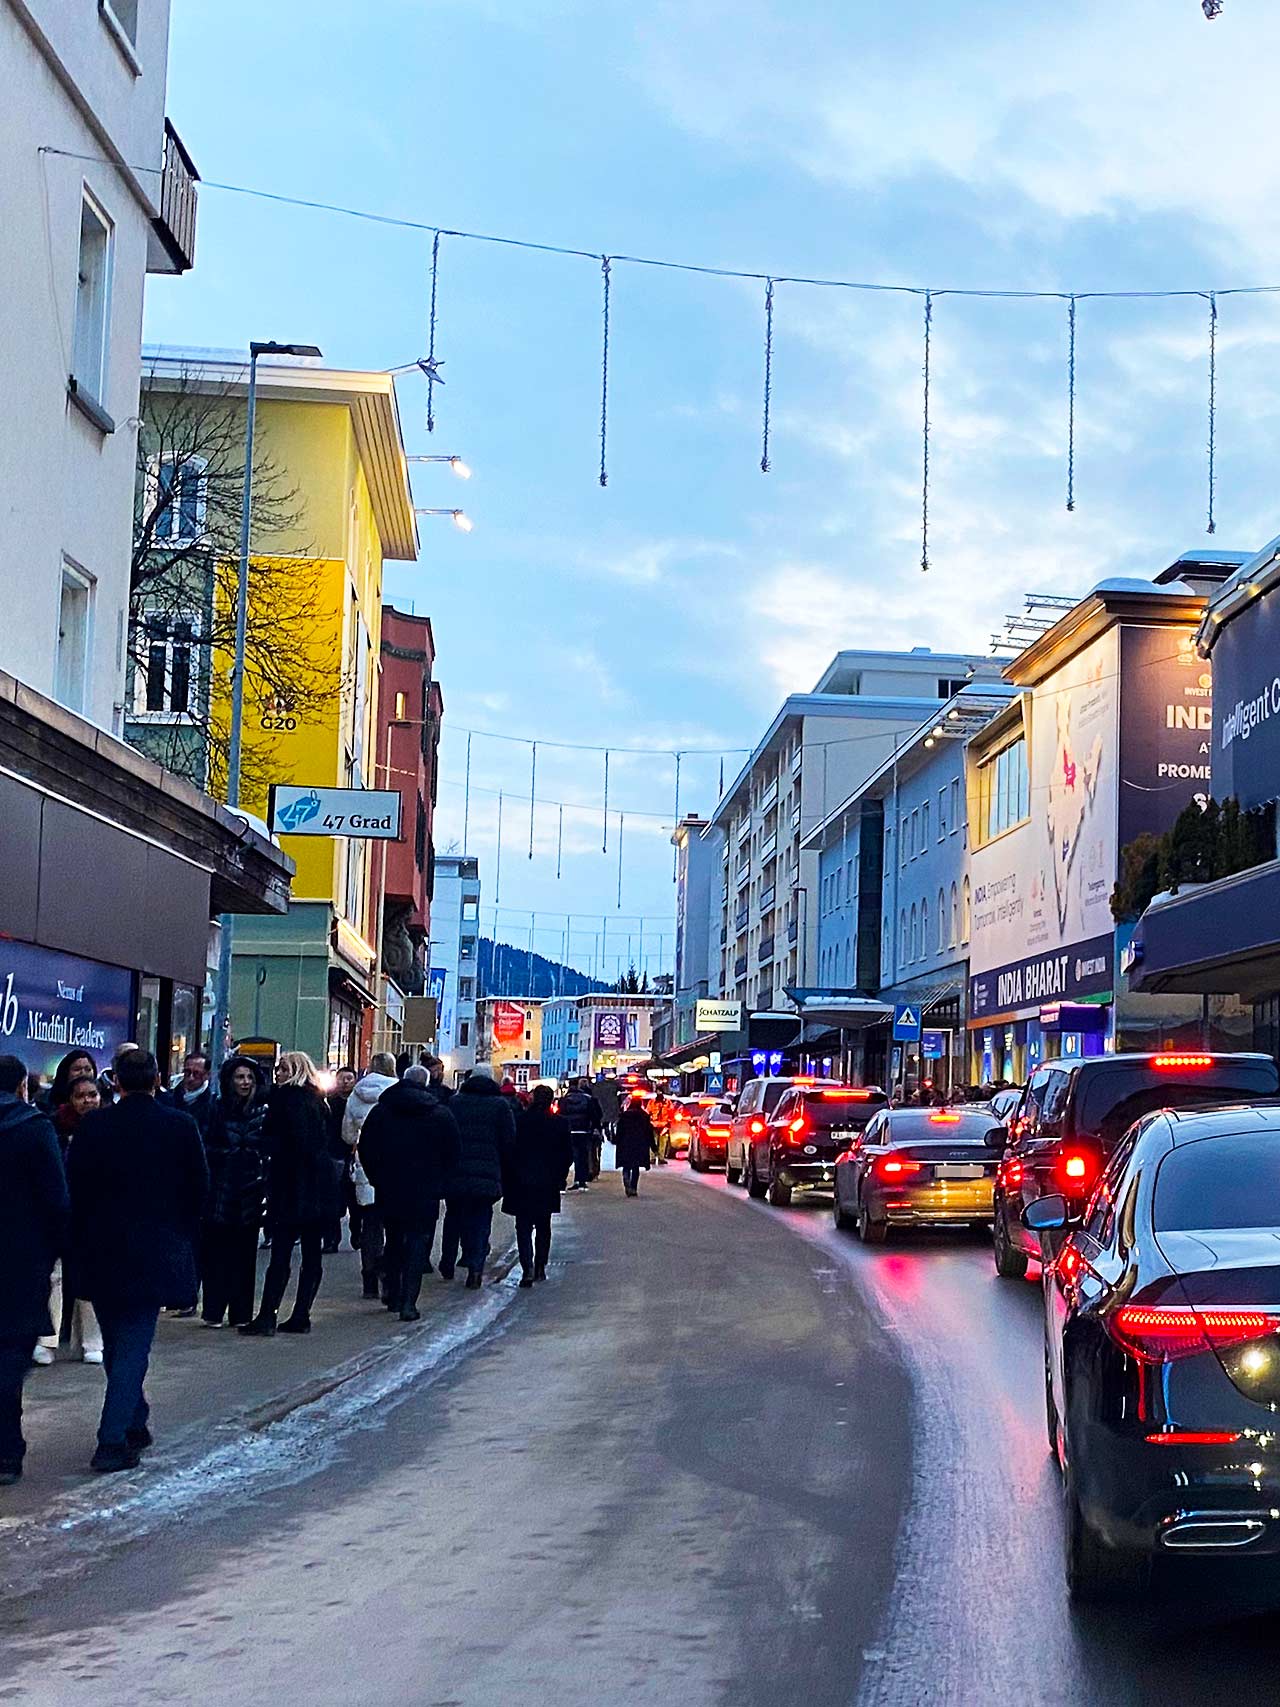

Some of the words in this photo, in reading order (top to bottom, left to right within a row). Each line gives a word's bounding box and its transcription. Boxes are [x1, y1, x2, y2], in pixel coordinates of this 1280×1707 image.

[260, 716, 297, 730] G20
[1221, 686, 1270, 749] Intelligent
[322, 814, 346, 830] 47
[349, 814, 391, 830] Grad
[997, 969, 1022, 1007] INDIA
[1025, 955, 1068, 1000] BHARAT
[27, 1010, 68, 1044] Mindful
[68, 1017, 105, 1049] Leaders
